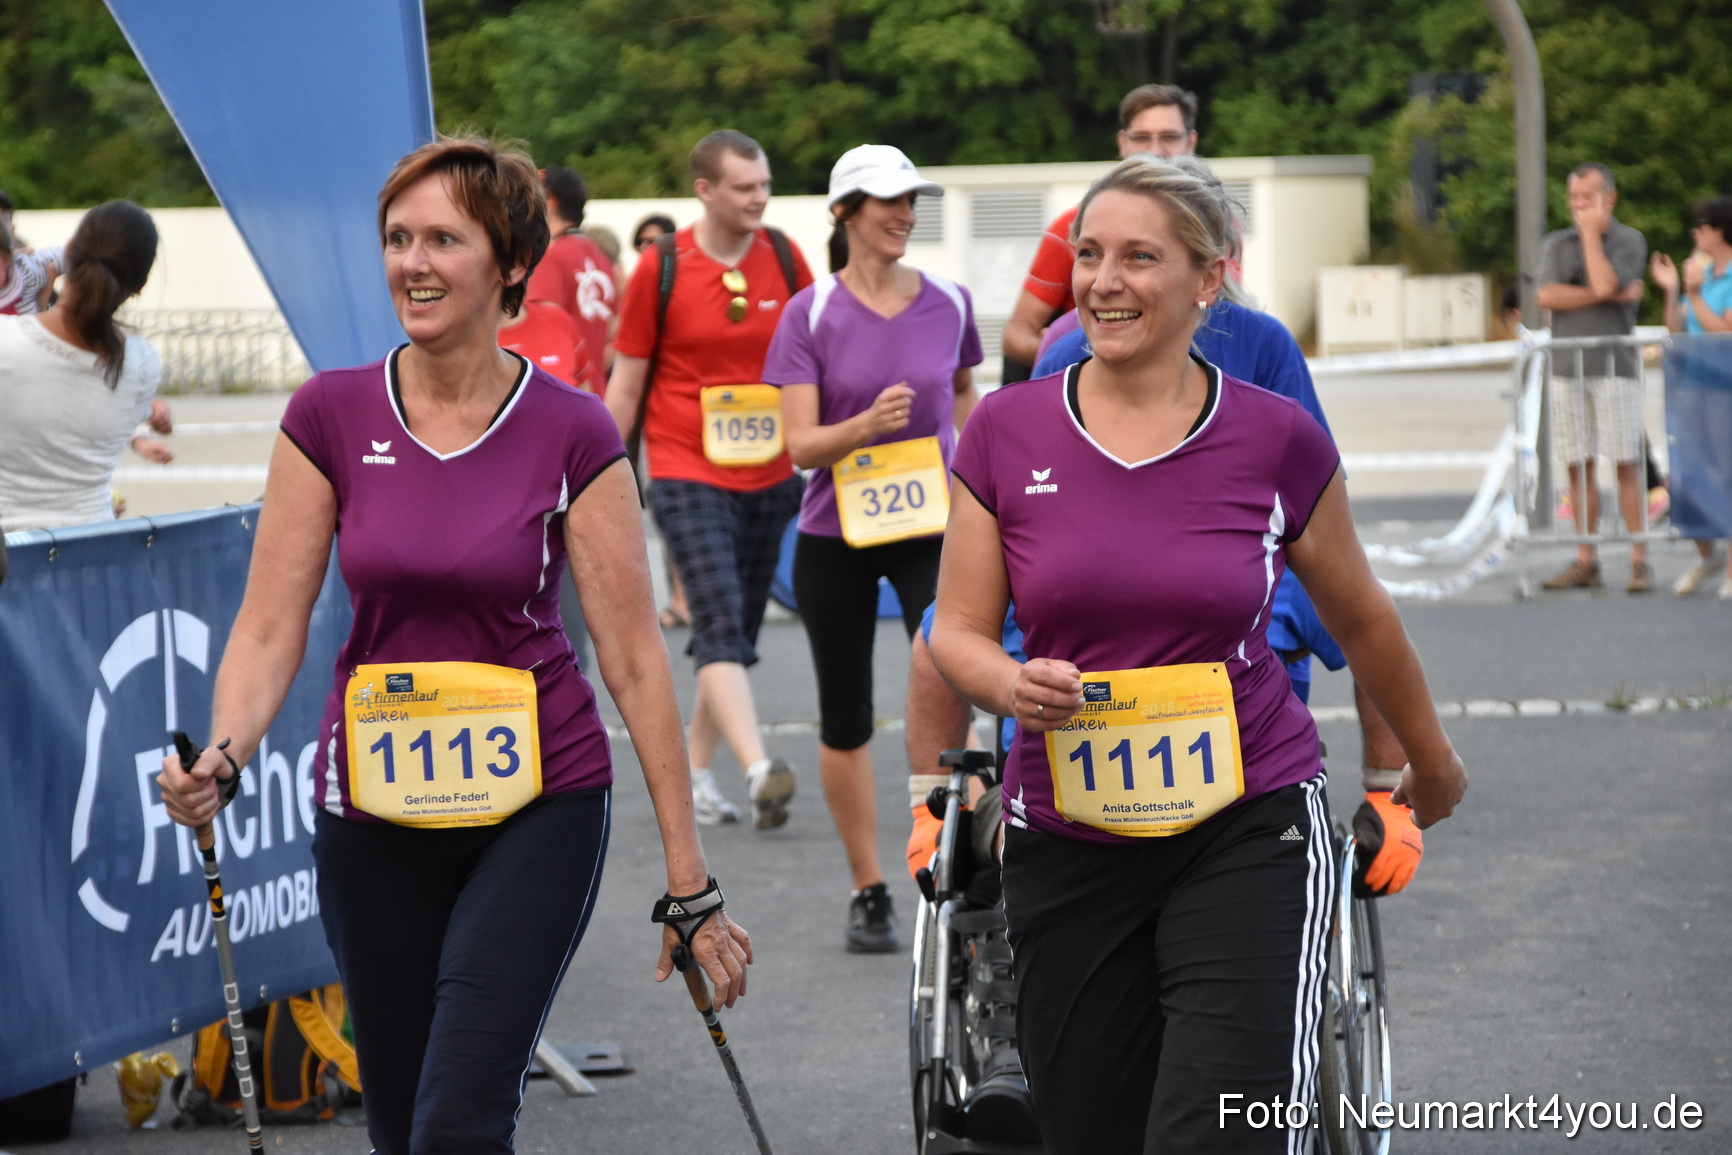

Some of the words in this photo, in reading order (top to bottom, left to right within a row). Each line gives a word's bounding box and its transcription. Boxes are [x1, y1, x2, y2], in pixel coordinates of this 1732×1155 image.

[712, 416, 776, 441] 1059
[362, 454, 396, 465] erima
[1025, 483, 1058, 495] erima
[861, 479, 926, 517] 320
[375, 689, 439, 704] firmenlauf
[1086, 697, 1137, 711] menlauf
[357, 709, 409, 723] walken
[370, 726, 520, 783] 1113
[1069, 731, 1214, 791] 1111
[405, 793, 451, 805] Gerlinde
[454, 791, 489, 802] Federl
[135, 732, 315, 884] Fch
[1102, 803, 1131, 813] Anita
[1133, 800, 1194, 812] Gottschalk
[150, 866, 319, 963] AUOMOBI
